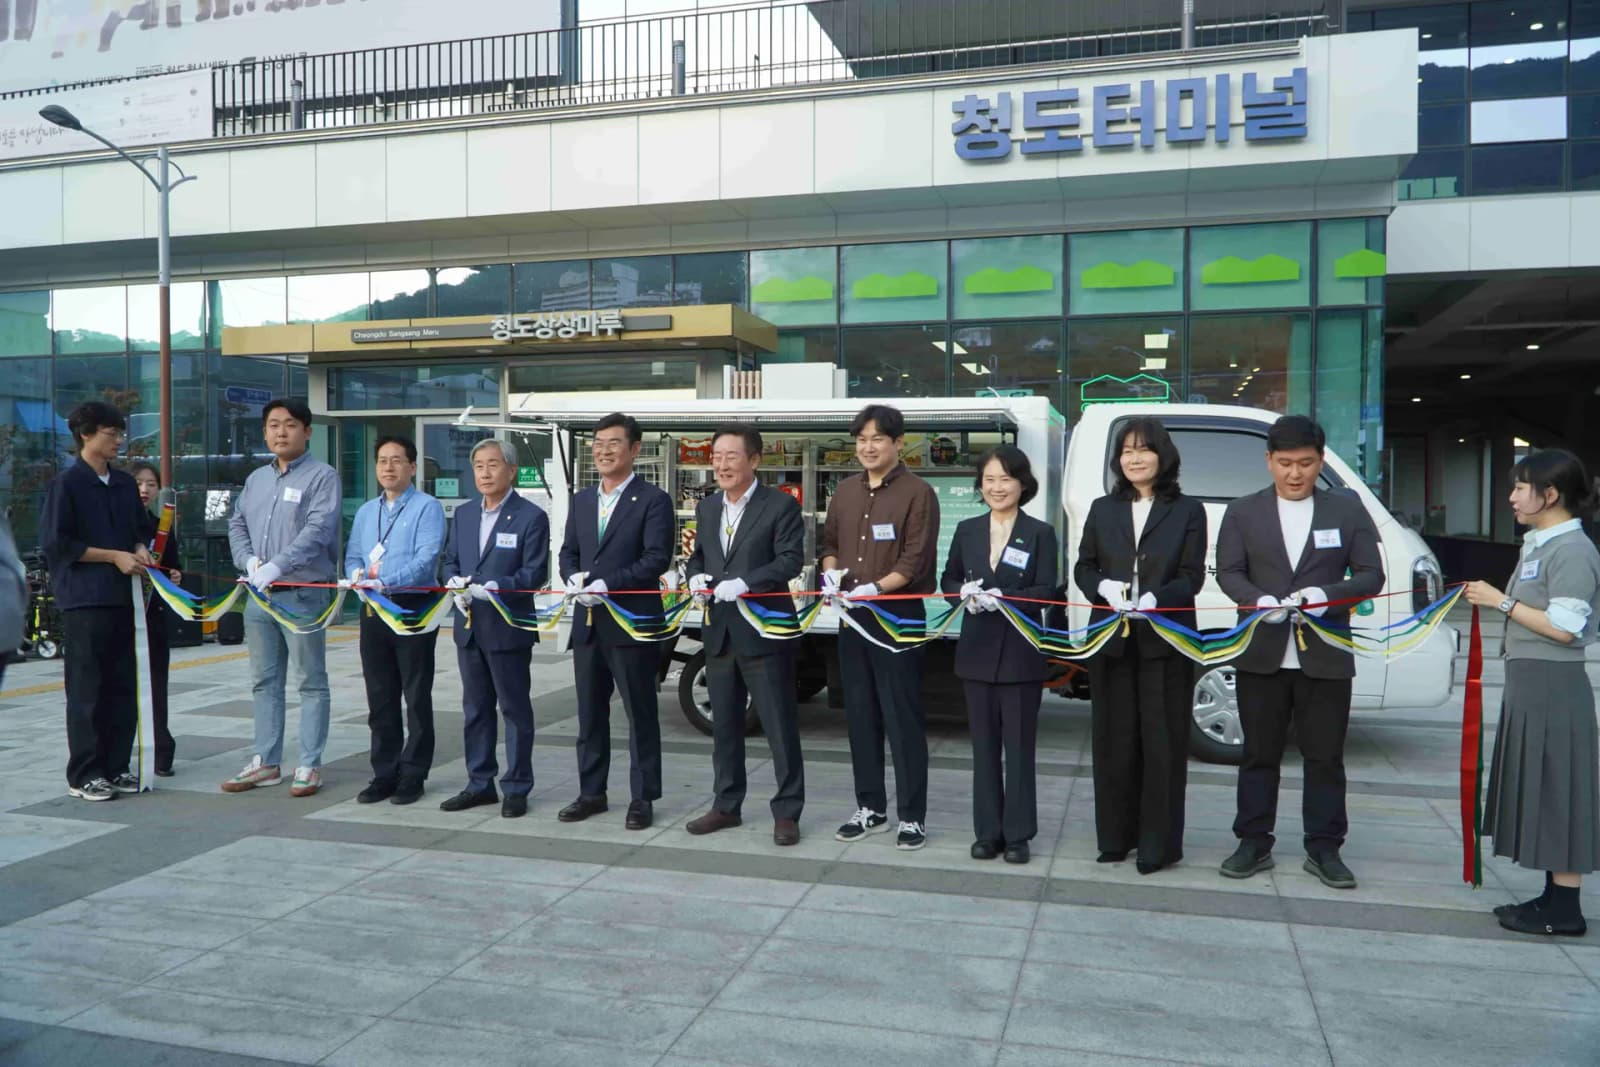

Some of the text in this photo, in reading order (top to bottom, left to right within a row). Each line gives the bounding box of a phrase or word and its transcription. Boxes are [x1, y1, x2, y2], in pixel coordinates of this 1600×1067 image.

[951, 67, 1308, 161] 청도터미널
[353, 328, 440, 340] Cheongdo Sangsang Maru
[490, 308, 625, 341] 청도상상마루
